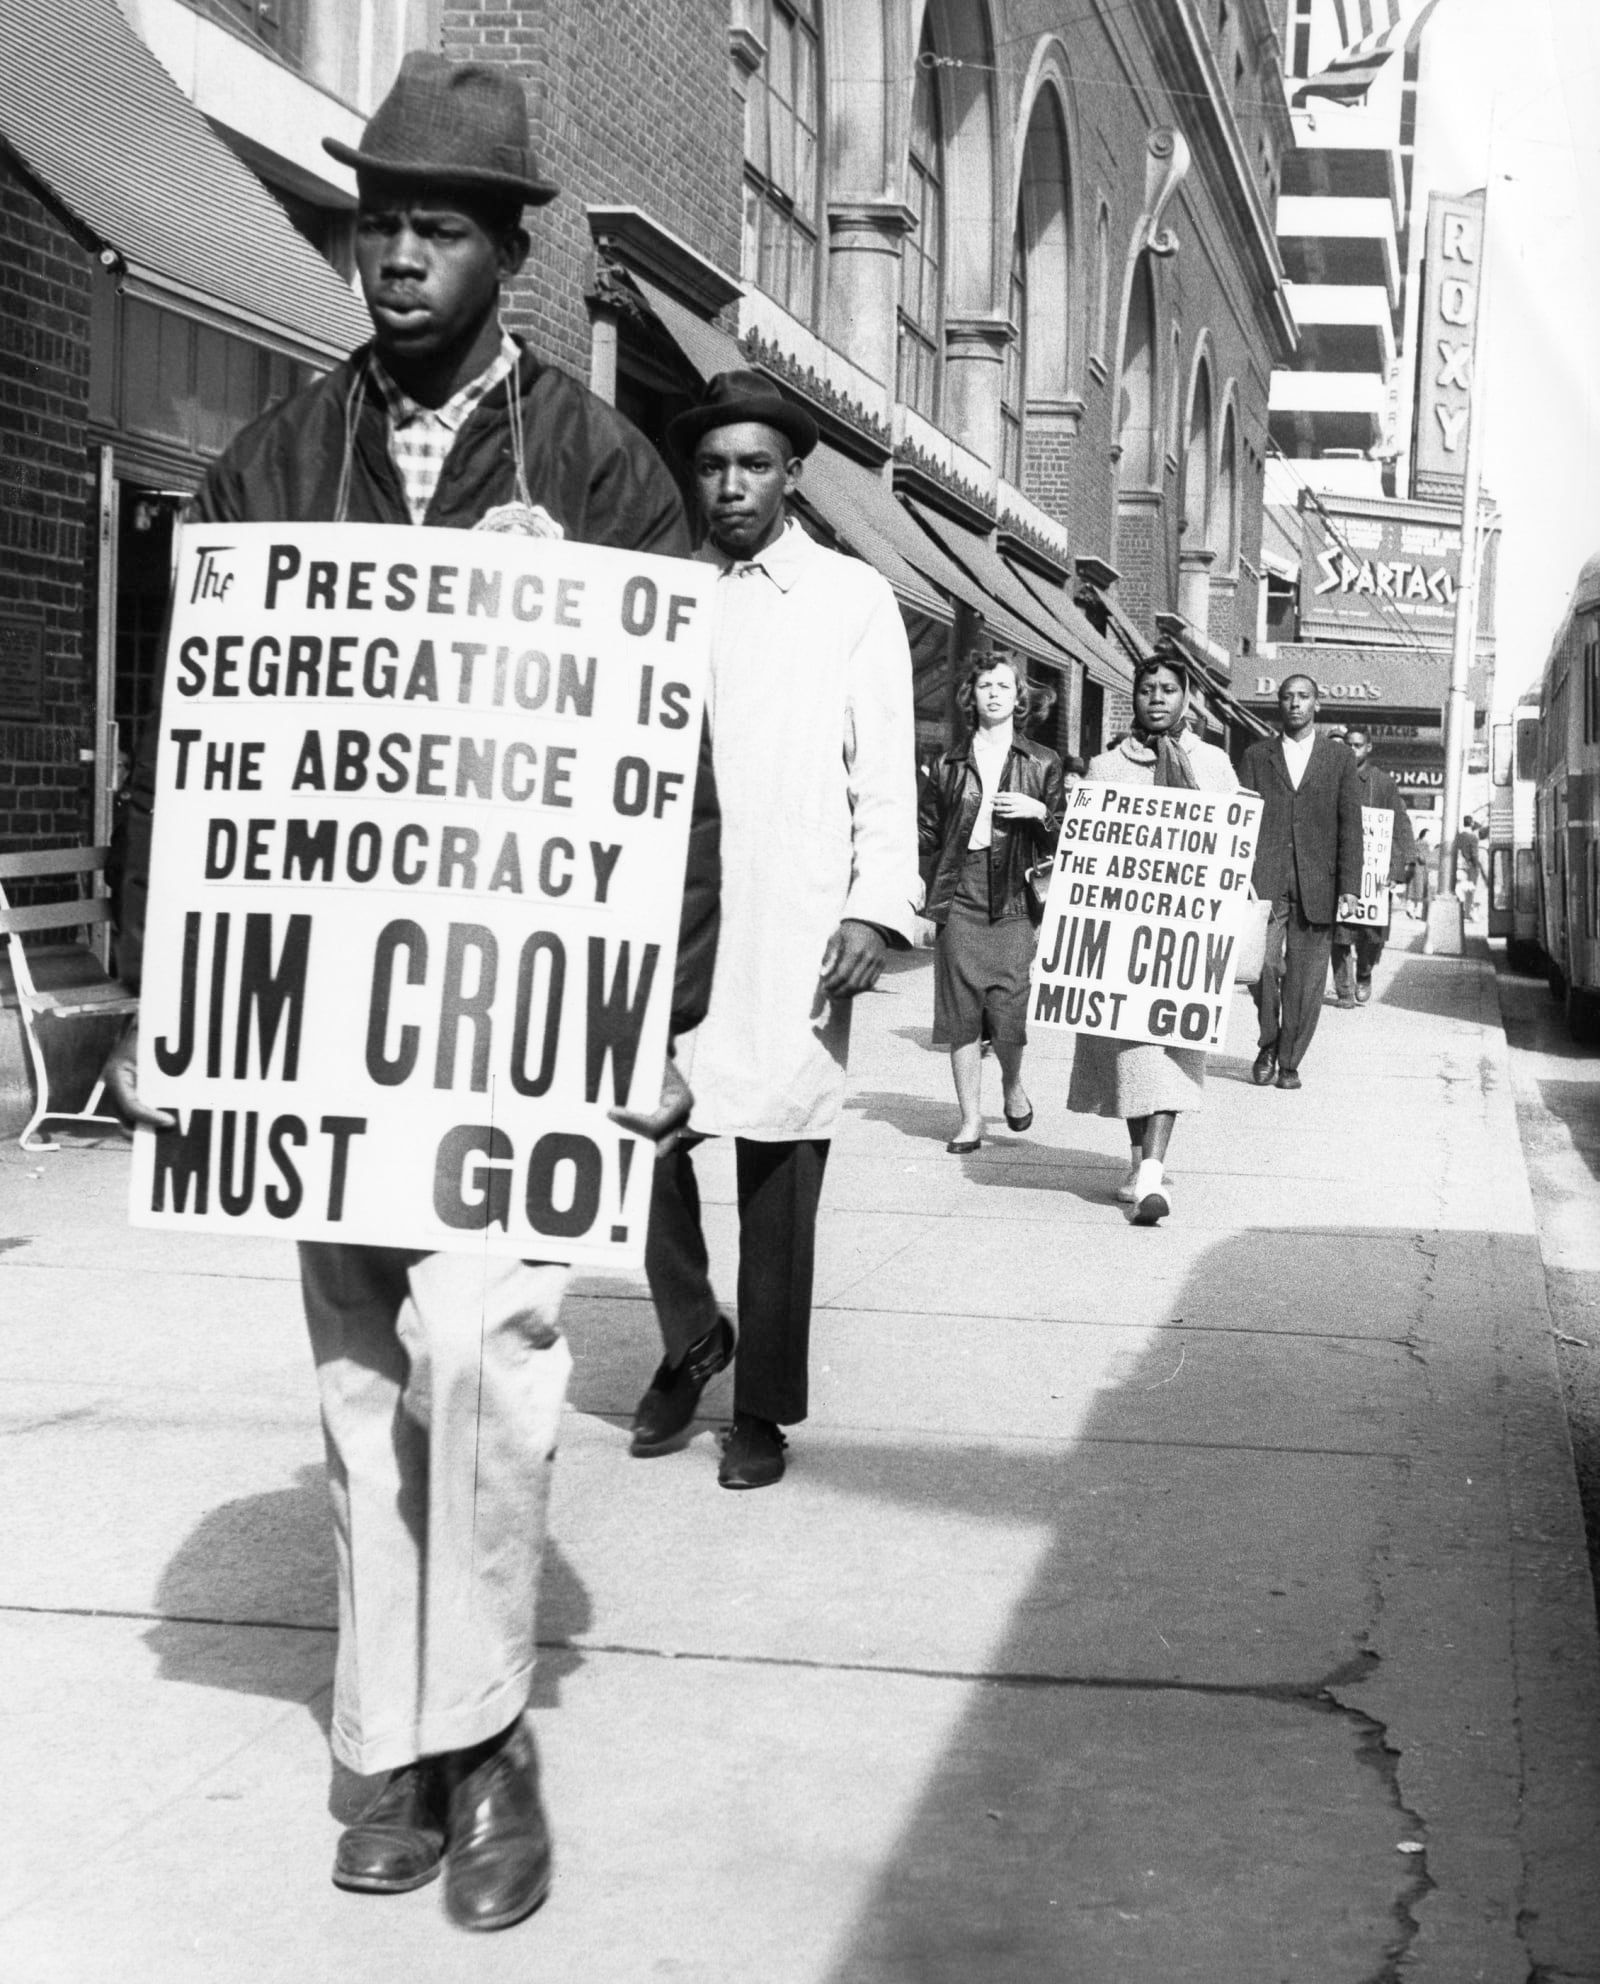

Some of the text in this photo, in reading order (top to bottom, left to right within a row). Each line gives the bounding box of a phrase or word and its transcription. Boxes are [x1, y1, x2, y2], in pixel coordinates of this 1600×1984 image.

[1434, 212, 1474, 453] ROXY
[190, 543, 697, 642] The PRESENCE OF
[1314, 545, 1457, 604] SPARTACU
[176, 635, 692, 730] SEGREGATION IS
[1255, 676, 1382, 701] Dson's
[170, 728, 686, 819] THE ABSENCE OF
[1074, 788, 1256, 827] The PRESENCE OF
[204, 818, 624, 905] DEMOCRACY
[1060, 850, 1247, 891] THE ABSENCE OF
[1065, 819, 1251, 859] SEGREGATION IS
[1069, 883, 1222, 922] DEMOCRACY
[1042, 915, 1235, 995] JIM CROW
[154, 910, 662, 1107] JIM CROW
[1035, 983, 1222, 1044] MUST GO!
[151, 1107, 638, 1244] MUST GO!
